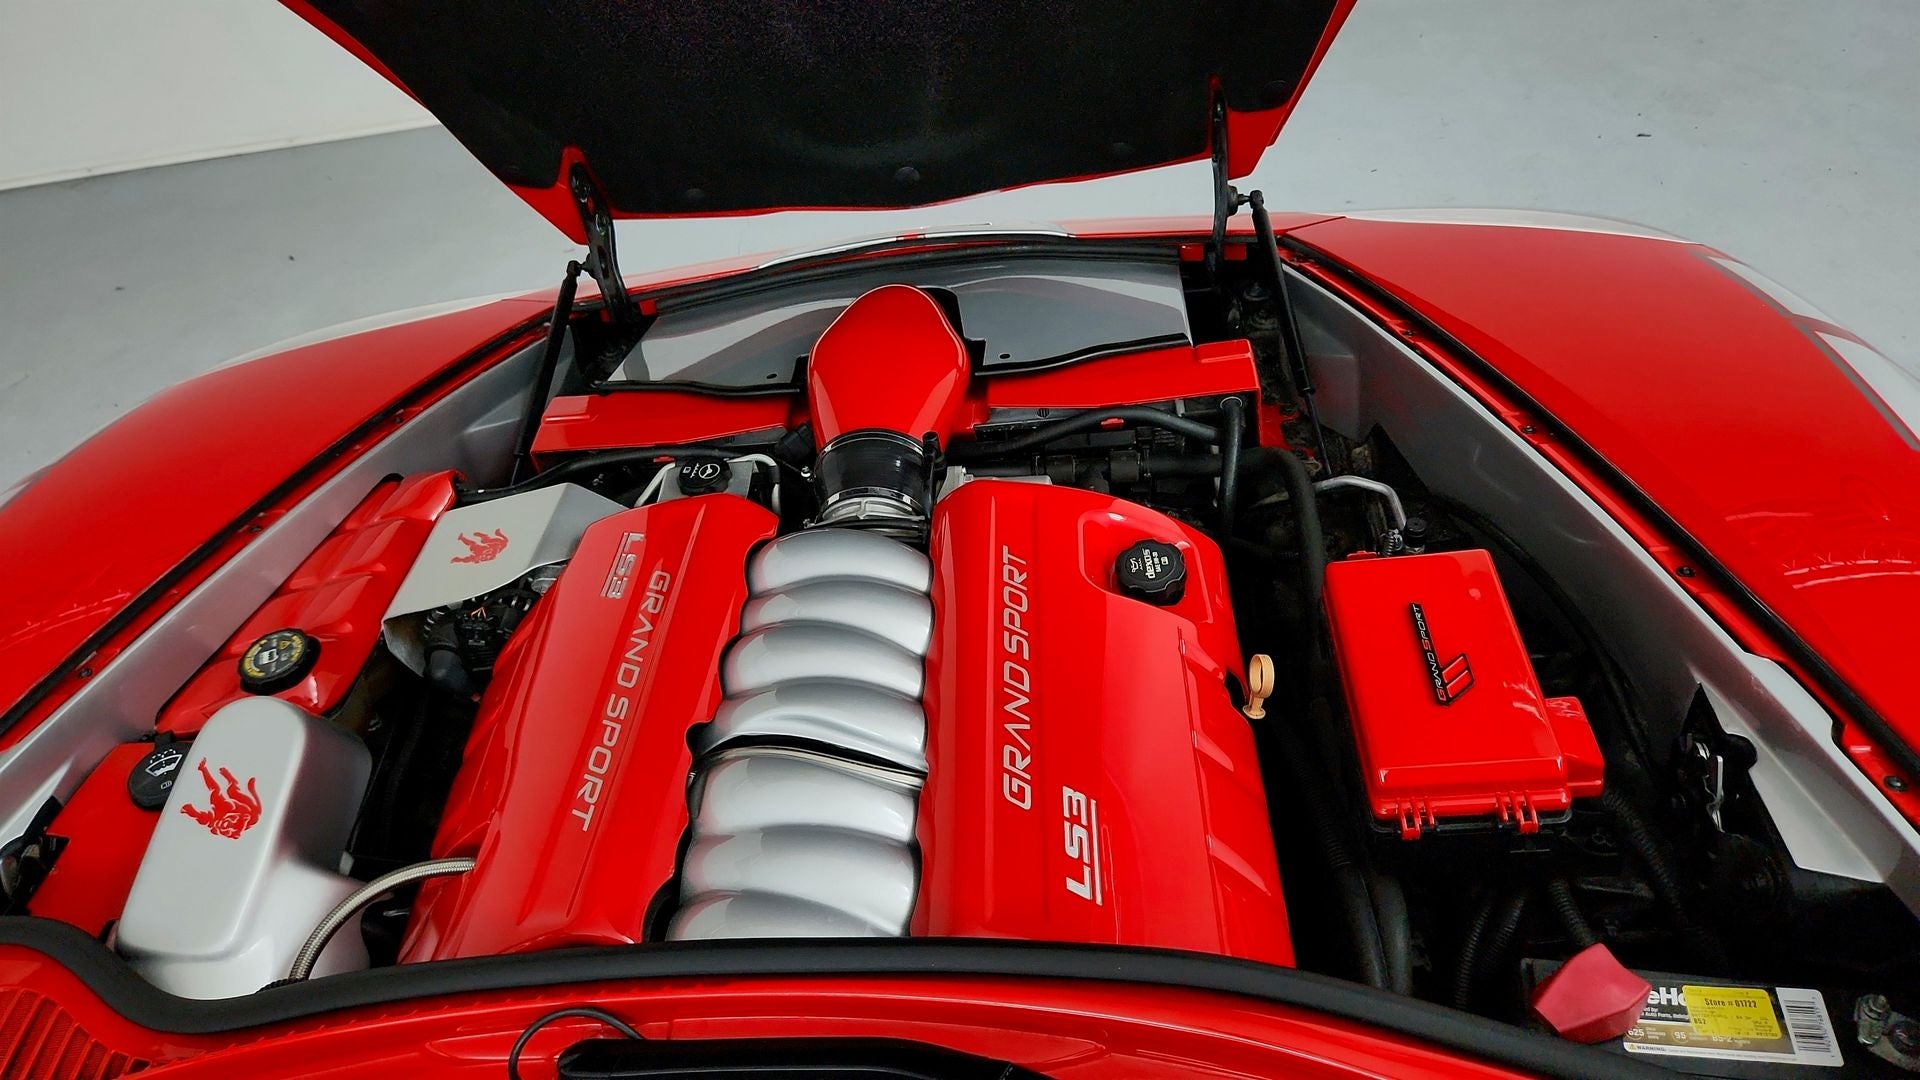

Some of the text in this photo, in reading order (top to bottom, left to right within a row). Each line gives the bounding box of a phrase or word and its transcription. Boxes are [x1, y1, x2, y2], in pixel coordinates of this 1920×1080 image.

[601, 532, 645, 599] LS3
[1142, 548, 1156, 579] dexos
[571, 569, 671, 832] GRAND SPORT
[1002, 545, 1032, 811] GRAND SPORT
[1412, 603, 1447, 701] GRAND SPORT
[1062, 786, 1093, 902] LS3
[1704, 998, 1726, 1007] Store
